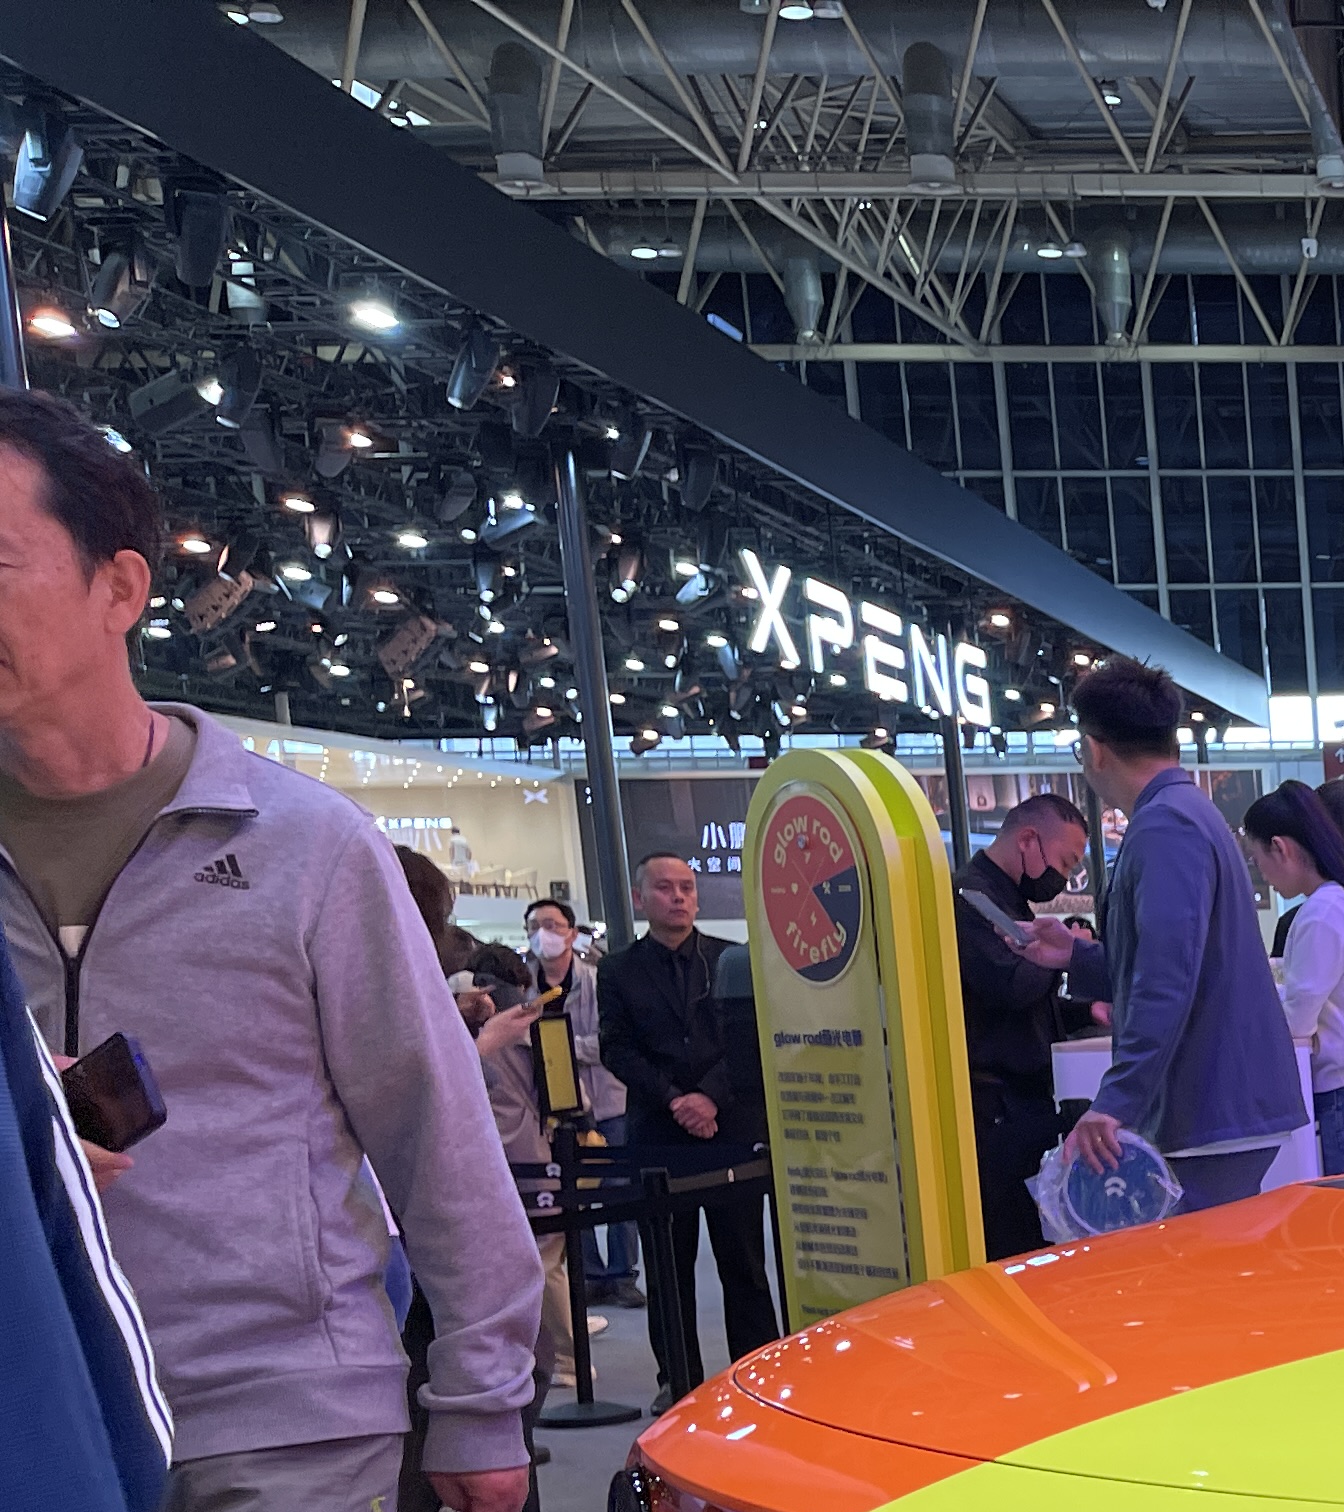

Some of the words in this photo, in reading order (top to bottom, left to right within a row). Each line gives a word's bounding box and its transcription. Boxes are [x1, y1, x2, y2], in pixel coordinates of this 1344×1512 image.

[738, 547, 992, 728] XPENG
[774, 814, 809, 868] glow
[812, 818, 844, 864] rod
[194, 872, 250, 890] adidas
[786, 921, 847, 964] firefly
